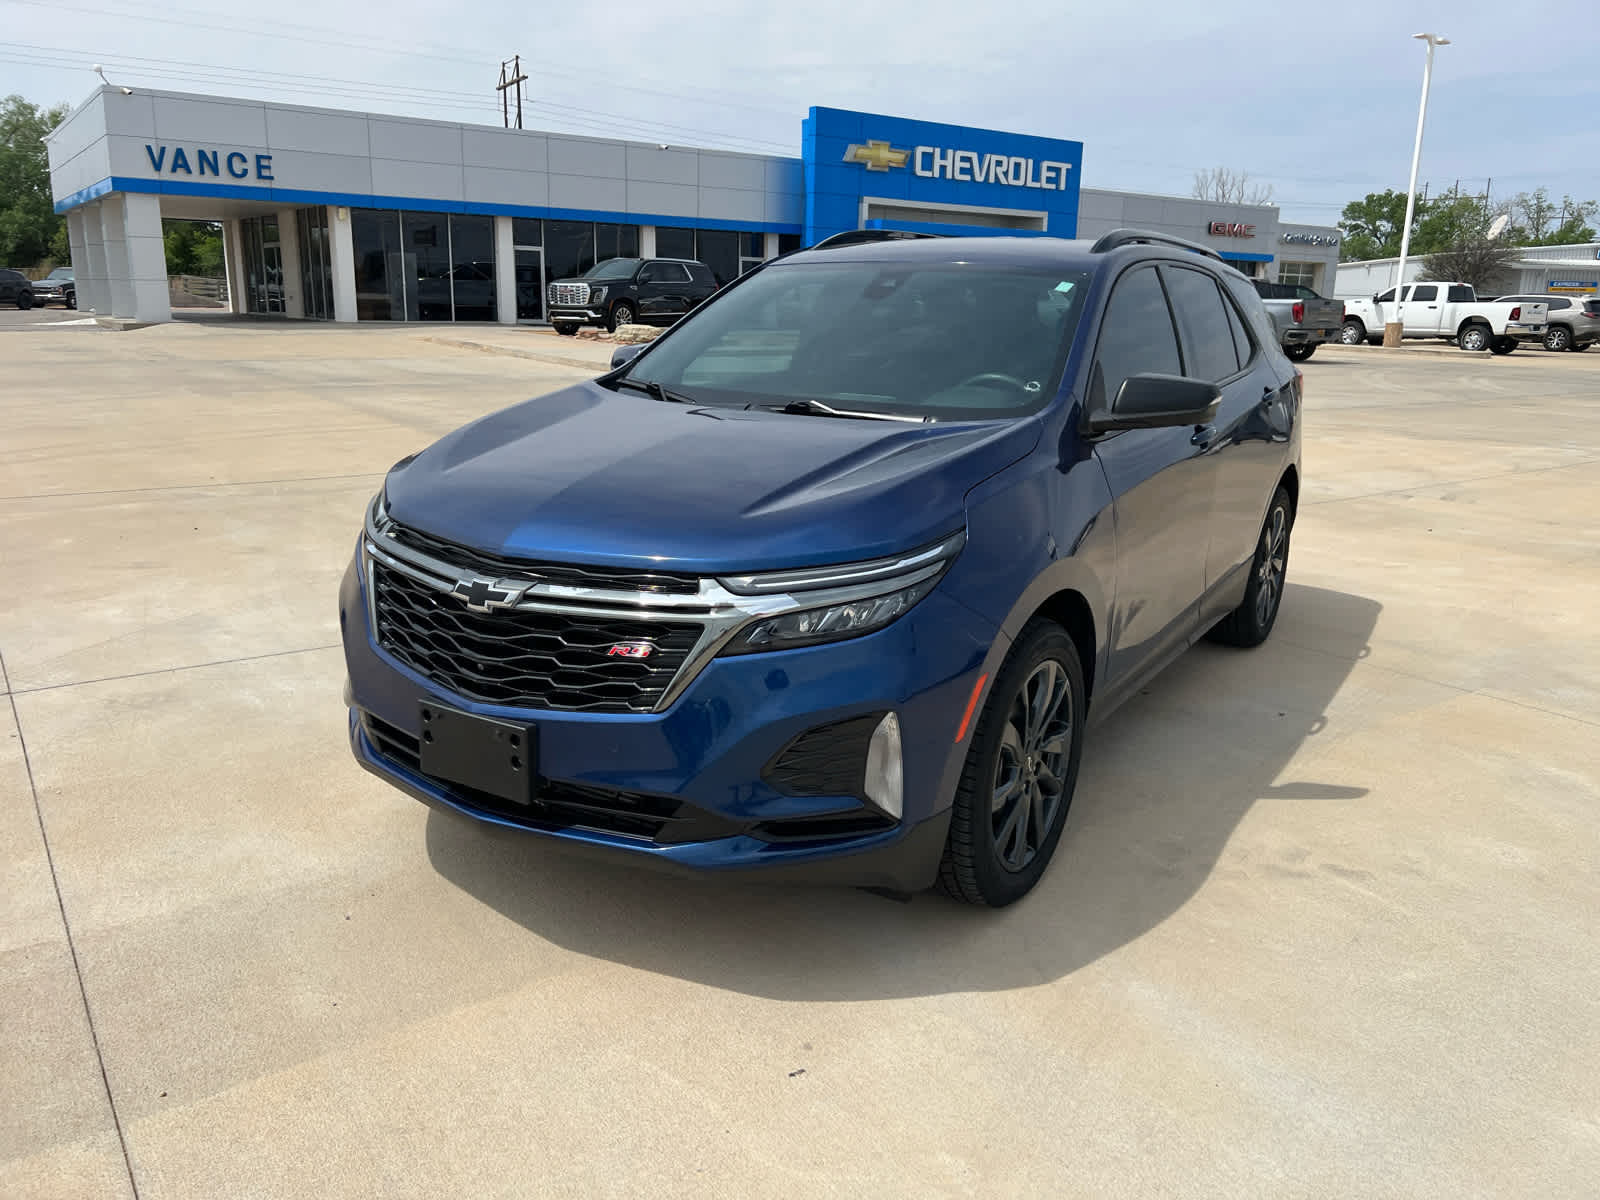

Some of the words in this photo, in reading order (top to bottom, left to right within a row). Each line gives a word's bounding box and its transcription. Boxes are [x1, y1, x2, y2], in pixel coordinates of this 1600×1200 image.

[144, 144, 275, 181] VANCE
[914, 146, 1073, 190] CHEVROLET
[1208, 221, 1257, 238] GMC
[607, 644, 652, 657] RS
